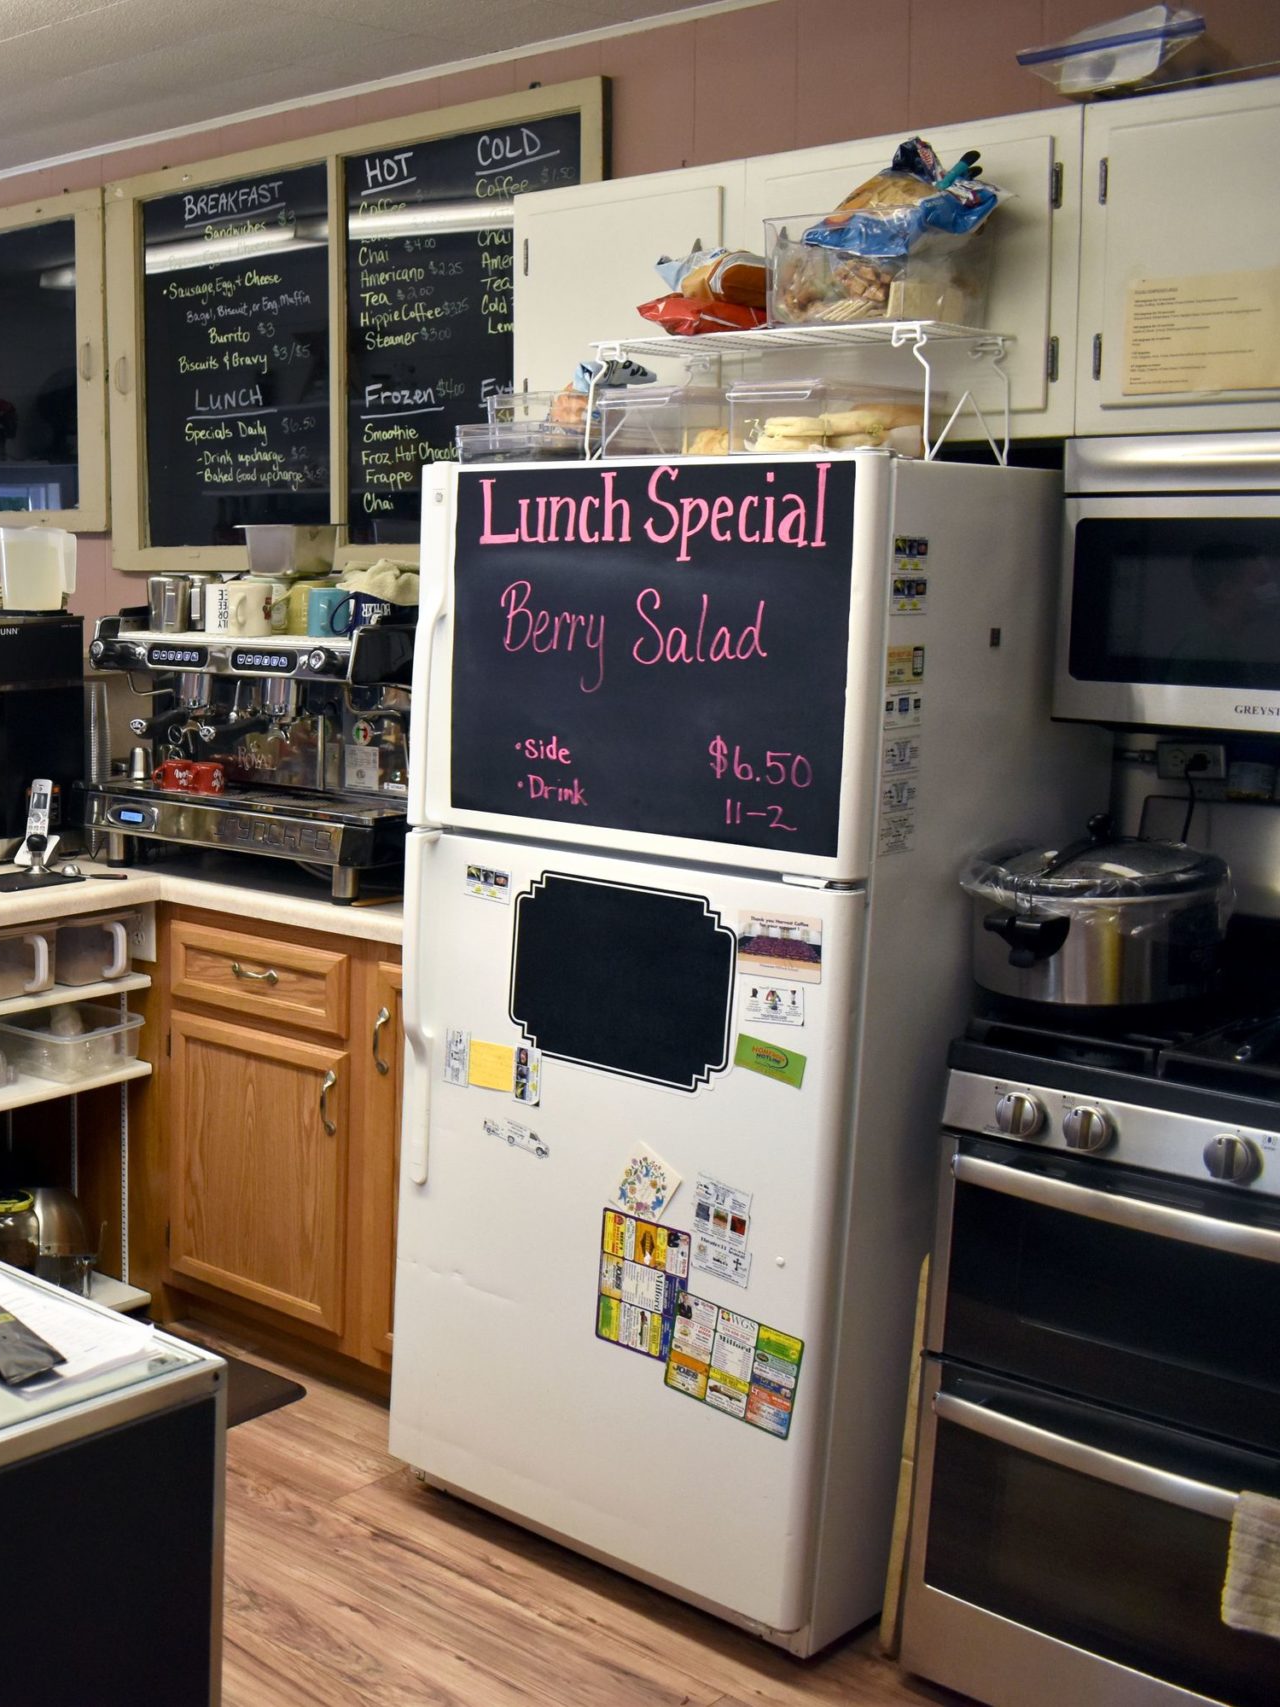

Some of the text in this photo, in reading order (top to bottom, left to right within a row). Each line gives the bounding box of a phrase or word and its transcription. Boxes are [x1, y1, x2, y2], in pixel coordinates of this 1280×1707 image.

[477, 128, 541, 166] COLD
[366, 151, 414, 187] HOT
[476, 176, 528, 200] Coffee
[183, 181, 283, 222] BREAKFAST
[204, 219, 267, 242] Sandwiches
[358, 244, 389, 266] Chai
[244, 270, 282, 287] Cheese
[360, 267, 425, 289] Americano
[280, 290, 312, 307] Muffin
[360, 292, 393, 308] Tea
[360, 310, 400, 331] Hippie
[401, 302, 444, 322] Coffee
[208, 326, 250, 344] Burrito
[365, 330, 419, 351] Steamer
[178, 355, 219, 374] Biscuits
[231, 353, 268, 375] Gravy
[194, 384, 264, 412] LUNCH
[364, 382, 435, 408] Frozen
[185, 421, 233, 445] Specials
[237, 419, 268, 447] Daily
[363, 423, 419, 444] Smoothie
[238, 447, 286, 471] upcharge
[395, 446, 417, 464] Hot
[260, 469, 305, 492] upcharge
[365, 469, 413, 493] Frappe
[363, 491, 395, 513] Chai
[479, 462, 832, 562] Lunch Special
[500, 580, 768, 693] Berry Salad
[708, 734, 813, 789] $6.50
[528, 774, 798, 831] Drink 11-2
[653, 1273, 664, 1313] Milford
[730, 1313, 757, 1332] WGS
[719, 1334, 753, 1354] Milford
